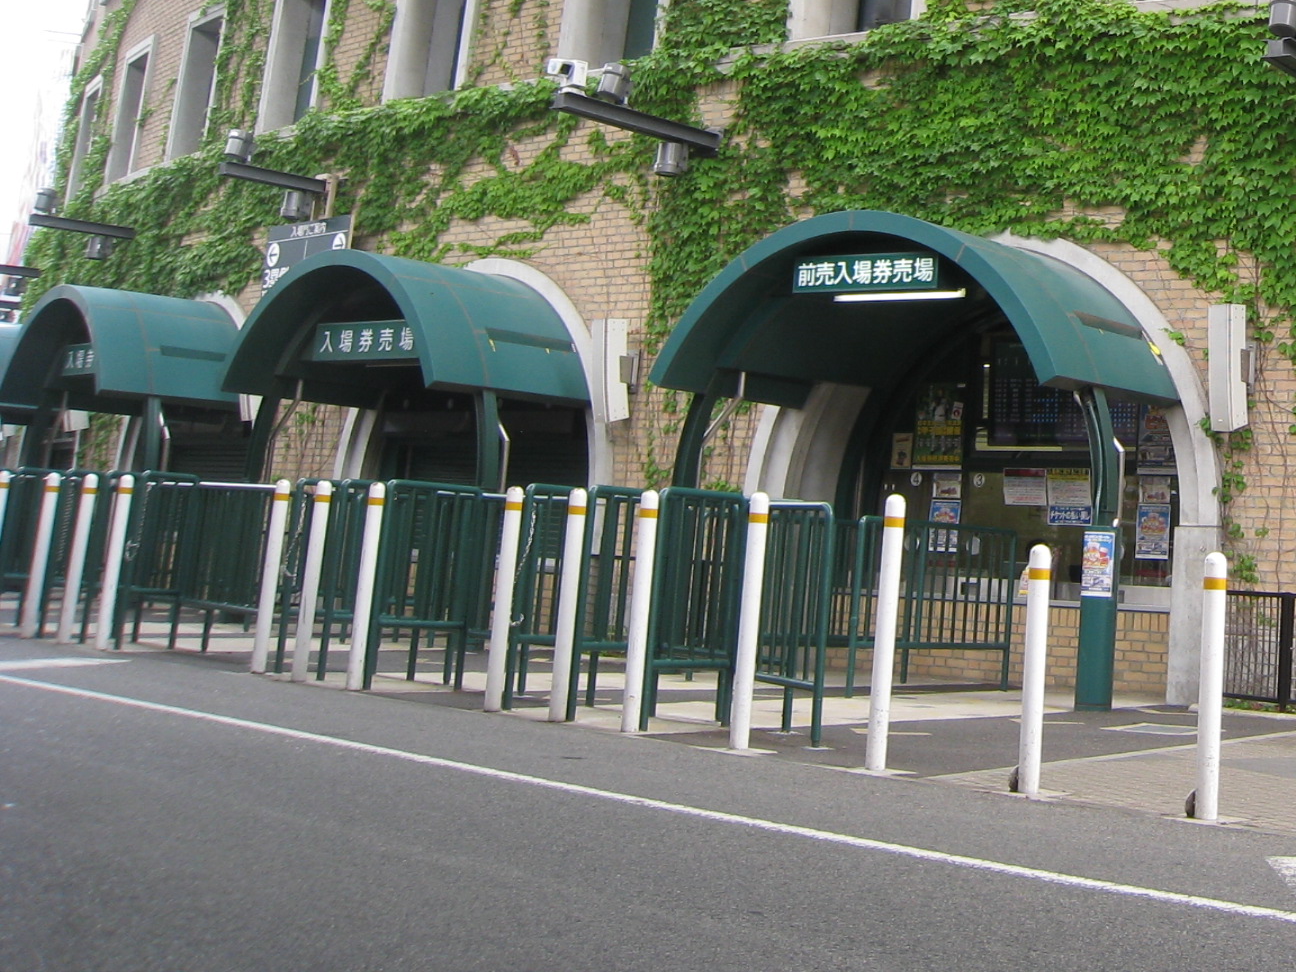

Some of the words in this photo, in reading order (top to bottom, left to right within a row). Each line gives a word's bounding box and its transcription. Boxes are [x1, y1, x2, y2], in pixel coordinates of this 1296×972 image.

[798, 257, 934, 287] 前売入場券売場
[319, 327, 414, 353] 入場券売場
